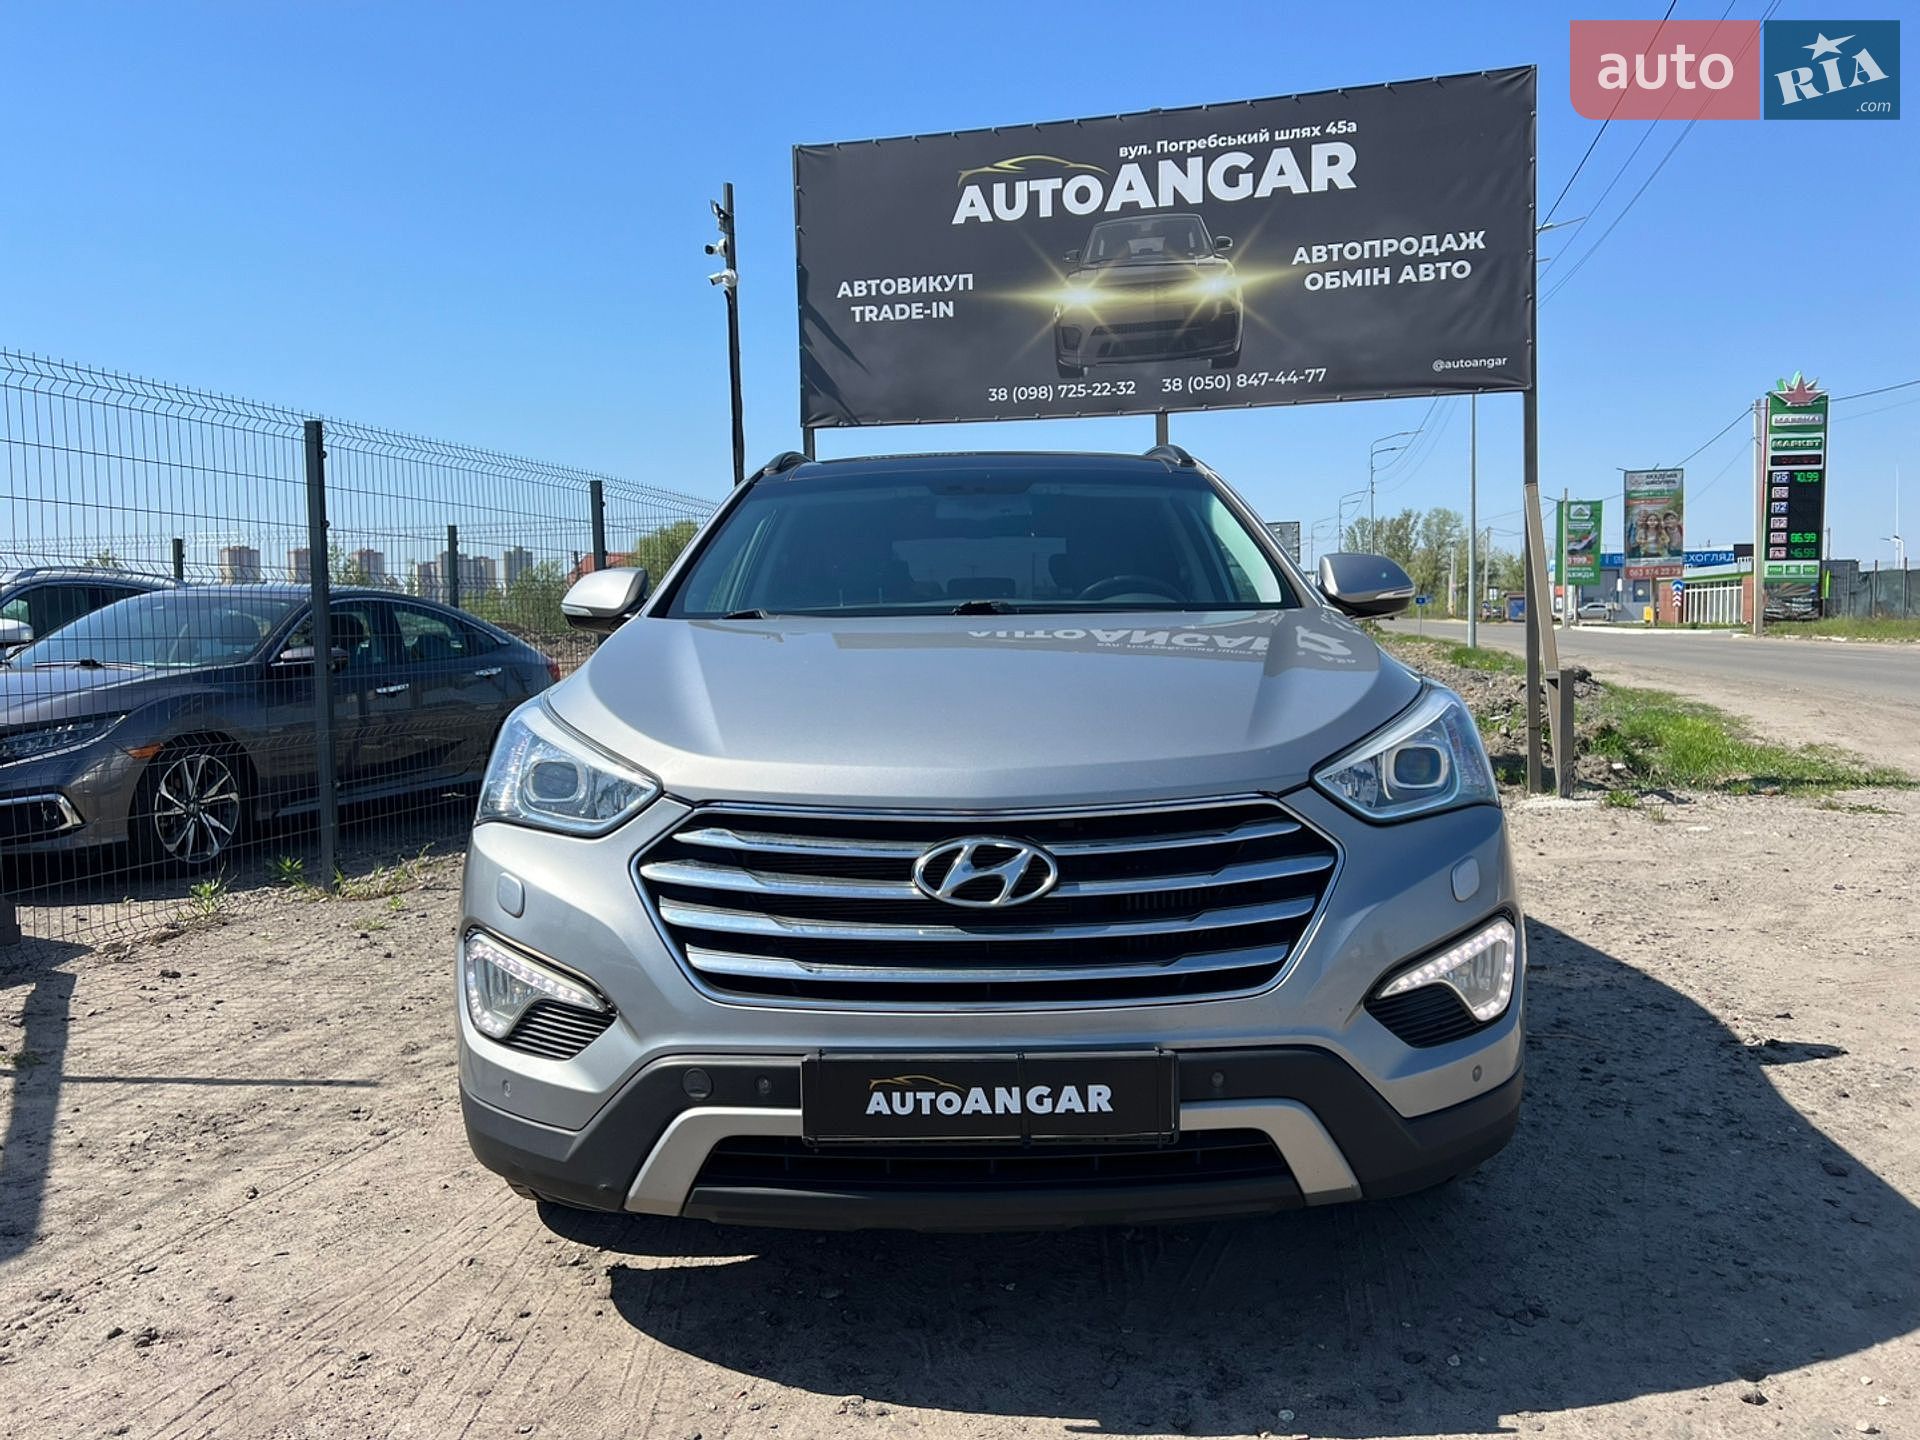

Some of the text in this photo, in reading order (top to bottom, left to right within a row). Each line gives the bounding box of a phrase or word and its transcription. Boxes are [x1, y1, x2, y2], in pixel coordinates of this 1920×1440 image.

[1119, 145, 1152, 159] вул.
[1156, 129, 1270, 154] Погребський
[1274, 125, 1321, 141] шлях
[951, 140, 1358, 225] AUTOANGAR
[1291, 230, 1486, 266] АВТОПРОДАЖ
[836, 273, 974, 299] АВТОВИКУП
[1303, 259, 1472, 292] ОБМІН АВТО
[850, 300, 955, 323] TRADE-IN
[1431, 357, 1508, 373] @autoangar
[987, 381, 1136, 403] 38 (098) 725-22-32
[1161, 367, 1327, 394] 38 (050) 847-44-77
[865, 1084, 1114, 1116] AUTOANGAR
